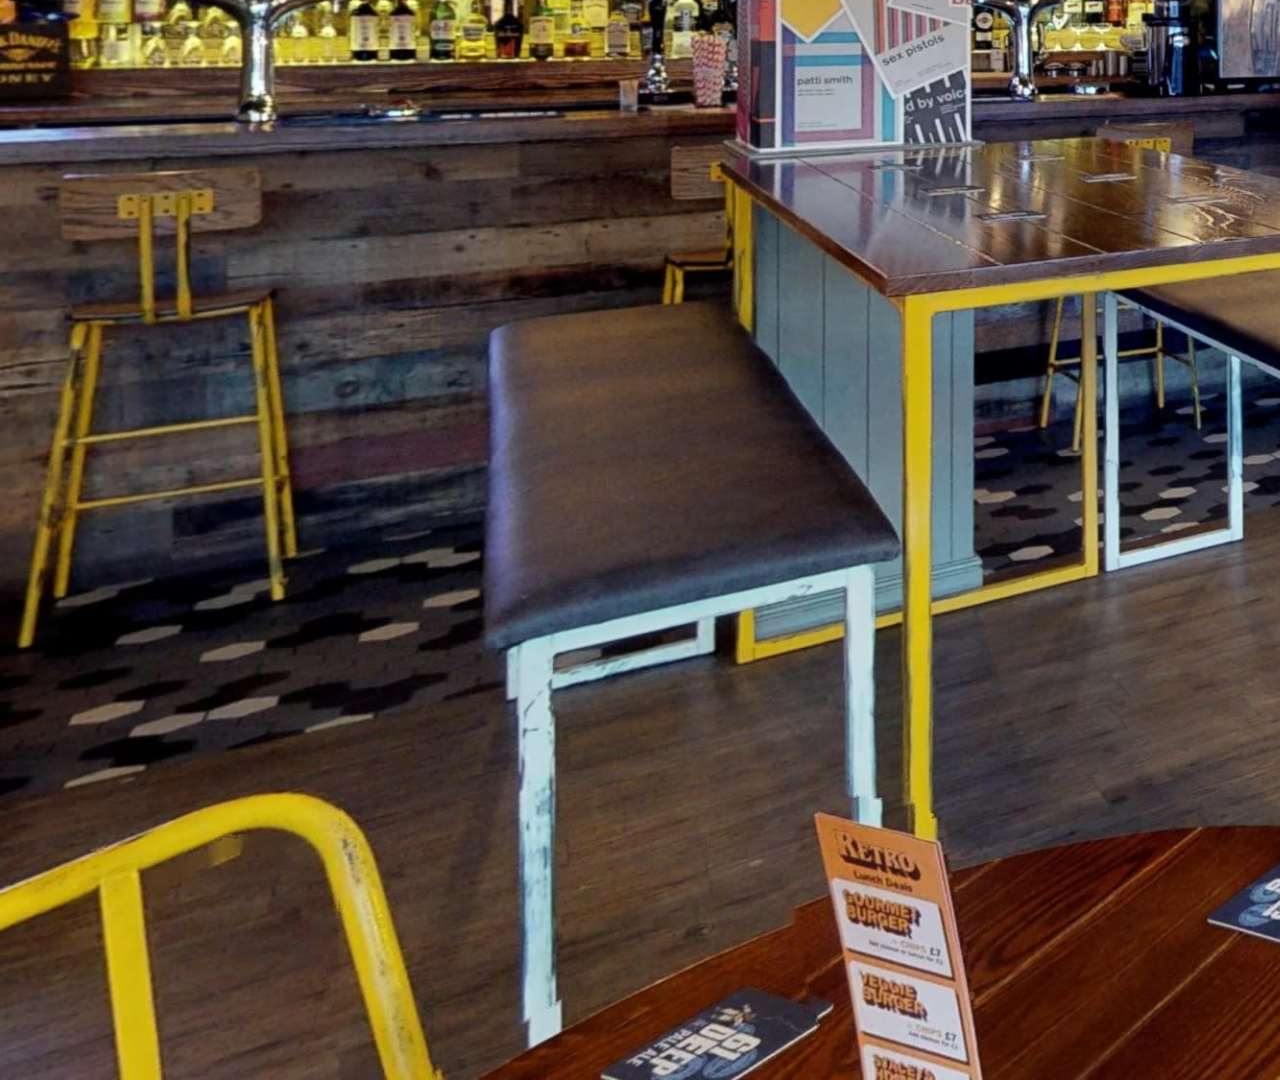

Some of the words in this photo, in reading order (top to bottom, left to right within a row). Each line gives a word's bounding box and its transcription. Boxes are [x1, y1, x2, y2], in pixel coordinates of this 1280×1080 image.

[882, 52, 905, 66] sex
[905, 33, 945, 59] pistols
[797, 75, 821, 86] patti
[822, 74, 853, 85] smith
[917, 93, 934, 109] by
[837, 830, 921, 881] RETRO
[853, 870, 883, 885] Lunch
[885, 877, 913, 892] Deals
[847, 904, 913, 939] BURGER
[863, 986, 928, 1022] BURGER
[650, 1023, 738, 1076] DEEP
[653, 1028, 694, 1049] PALE
[709, 1032, 763, 1062] 61
[625, 1047, 657, 1068] ALE
